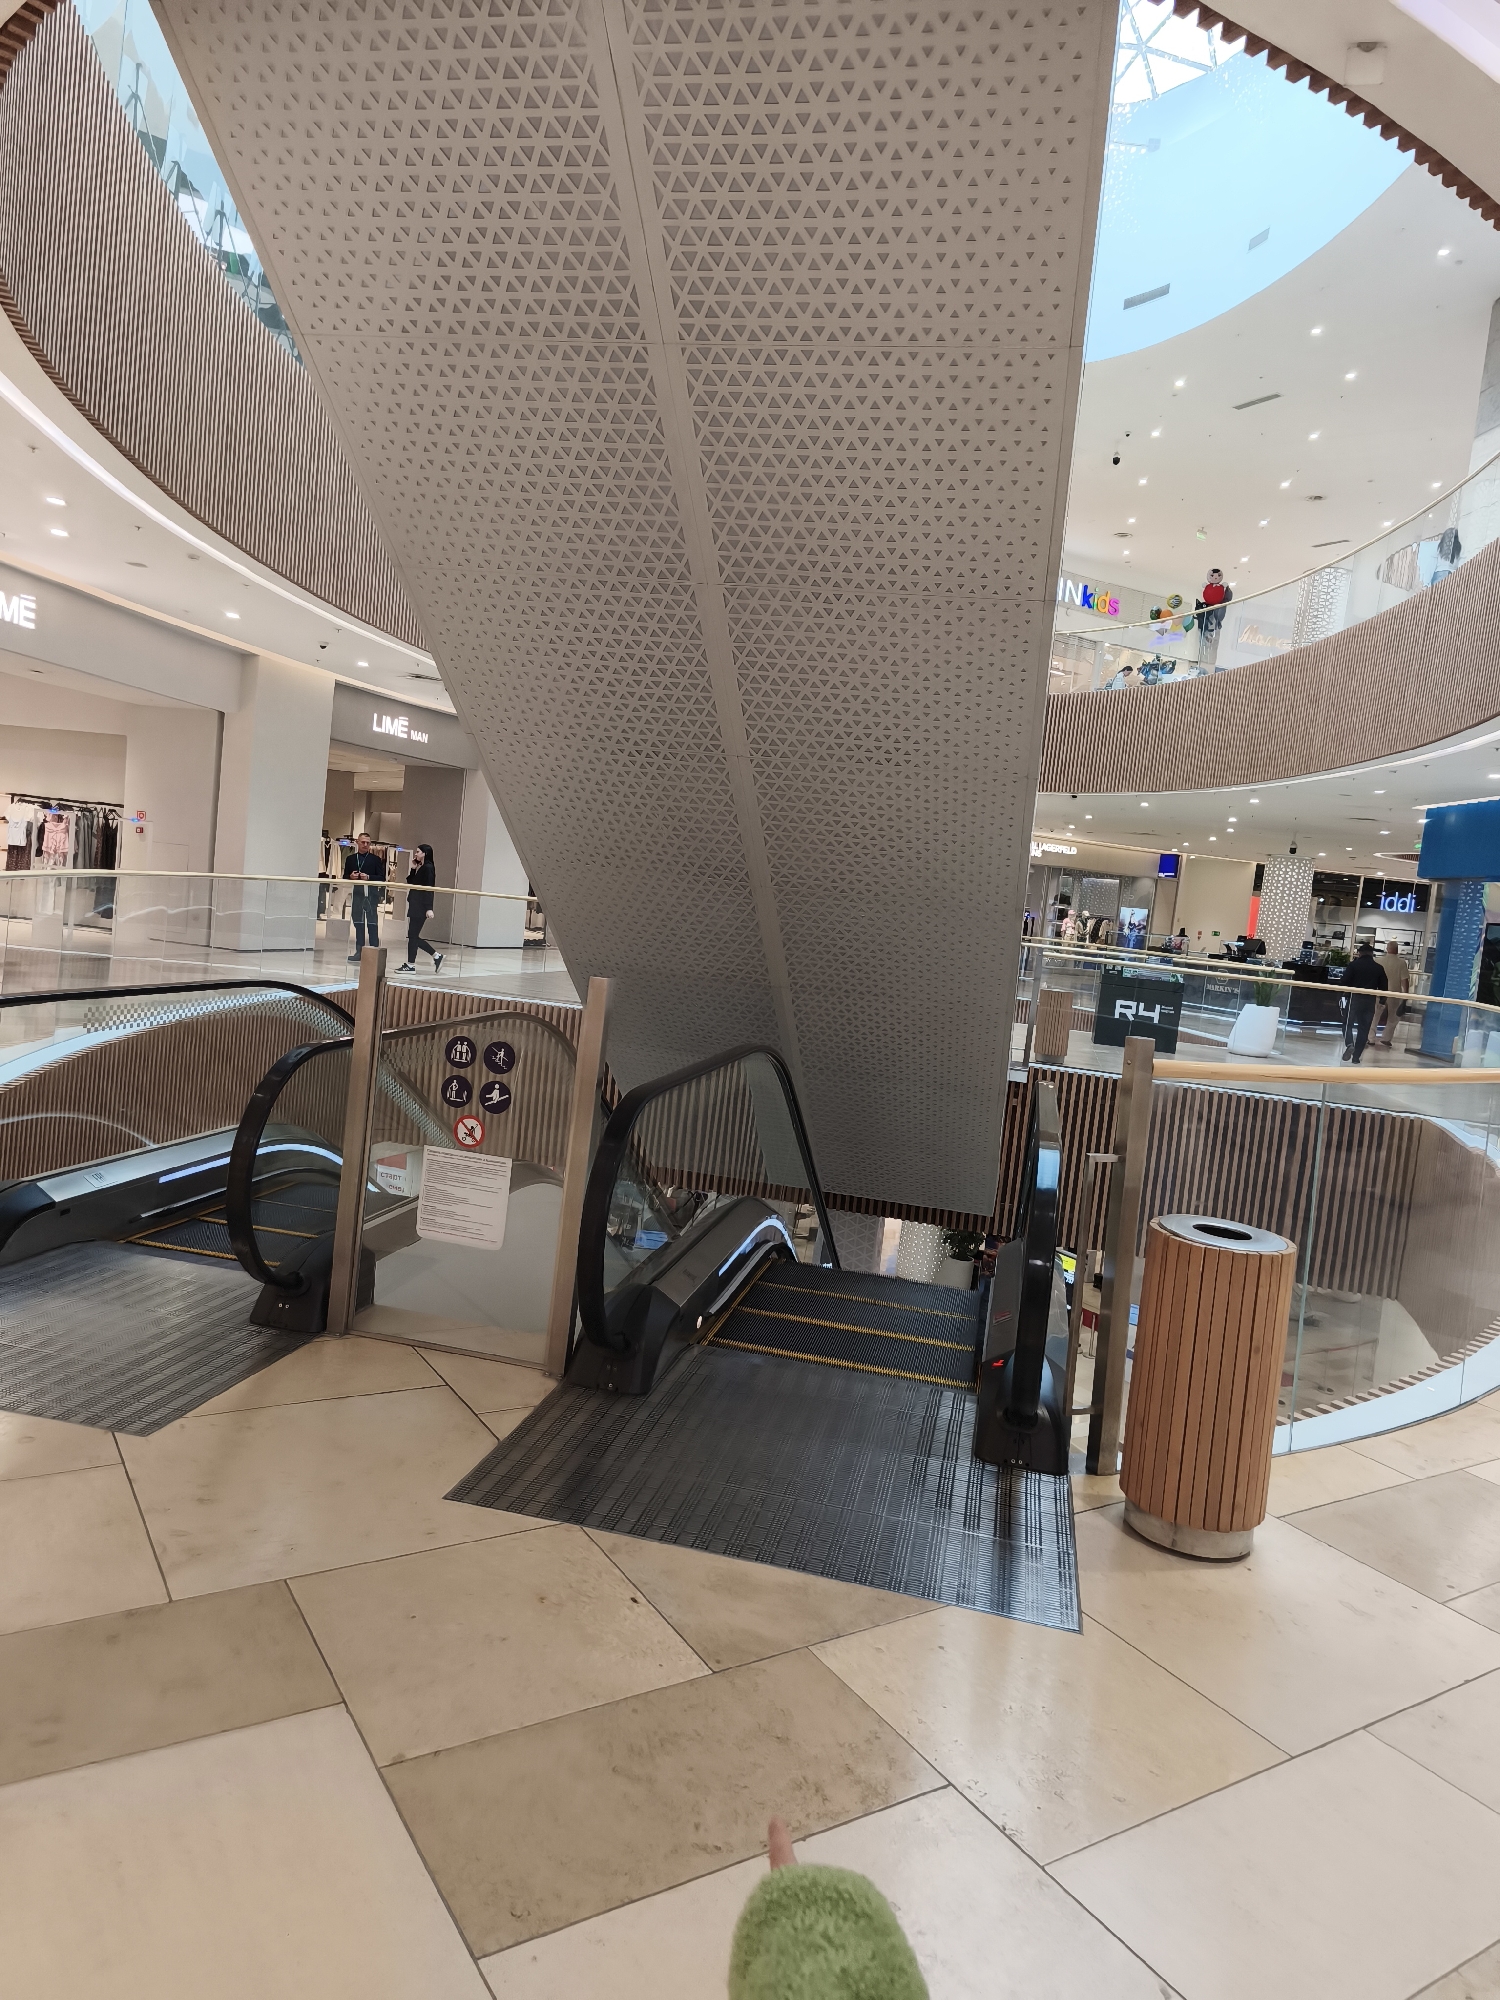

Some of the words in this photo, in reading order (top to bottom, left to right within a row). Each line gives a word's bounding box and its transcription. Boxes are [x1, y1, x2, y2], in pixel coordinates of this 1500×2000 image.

[410, 730, 429, 743] MAN
[1040, 841, 1077, 855] LAGERFELD
[1380, 891, 1417, 914] iddi
[1114, 999, 1161, 1024] R4
